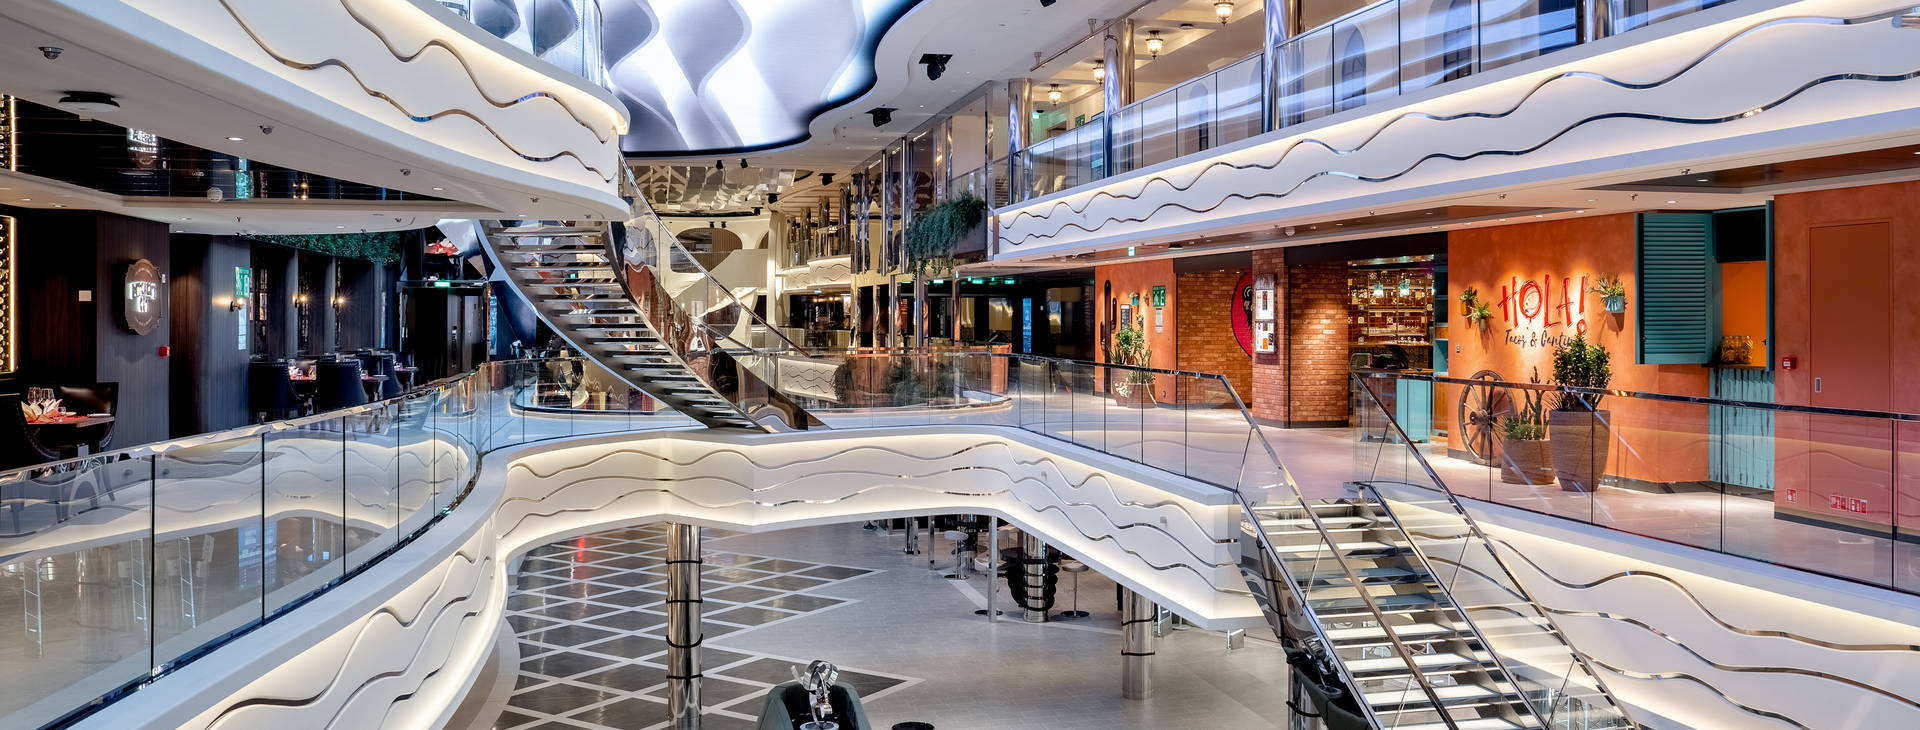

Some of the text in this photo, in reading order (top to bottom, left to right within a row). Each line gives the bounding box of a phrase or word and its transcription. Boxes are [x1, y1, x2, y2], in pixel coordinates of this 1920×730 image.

[1497, 274, 1587, 334] HOLA!
[1504, 329, 1575, 348] Tacos & Cantin
